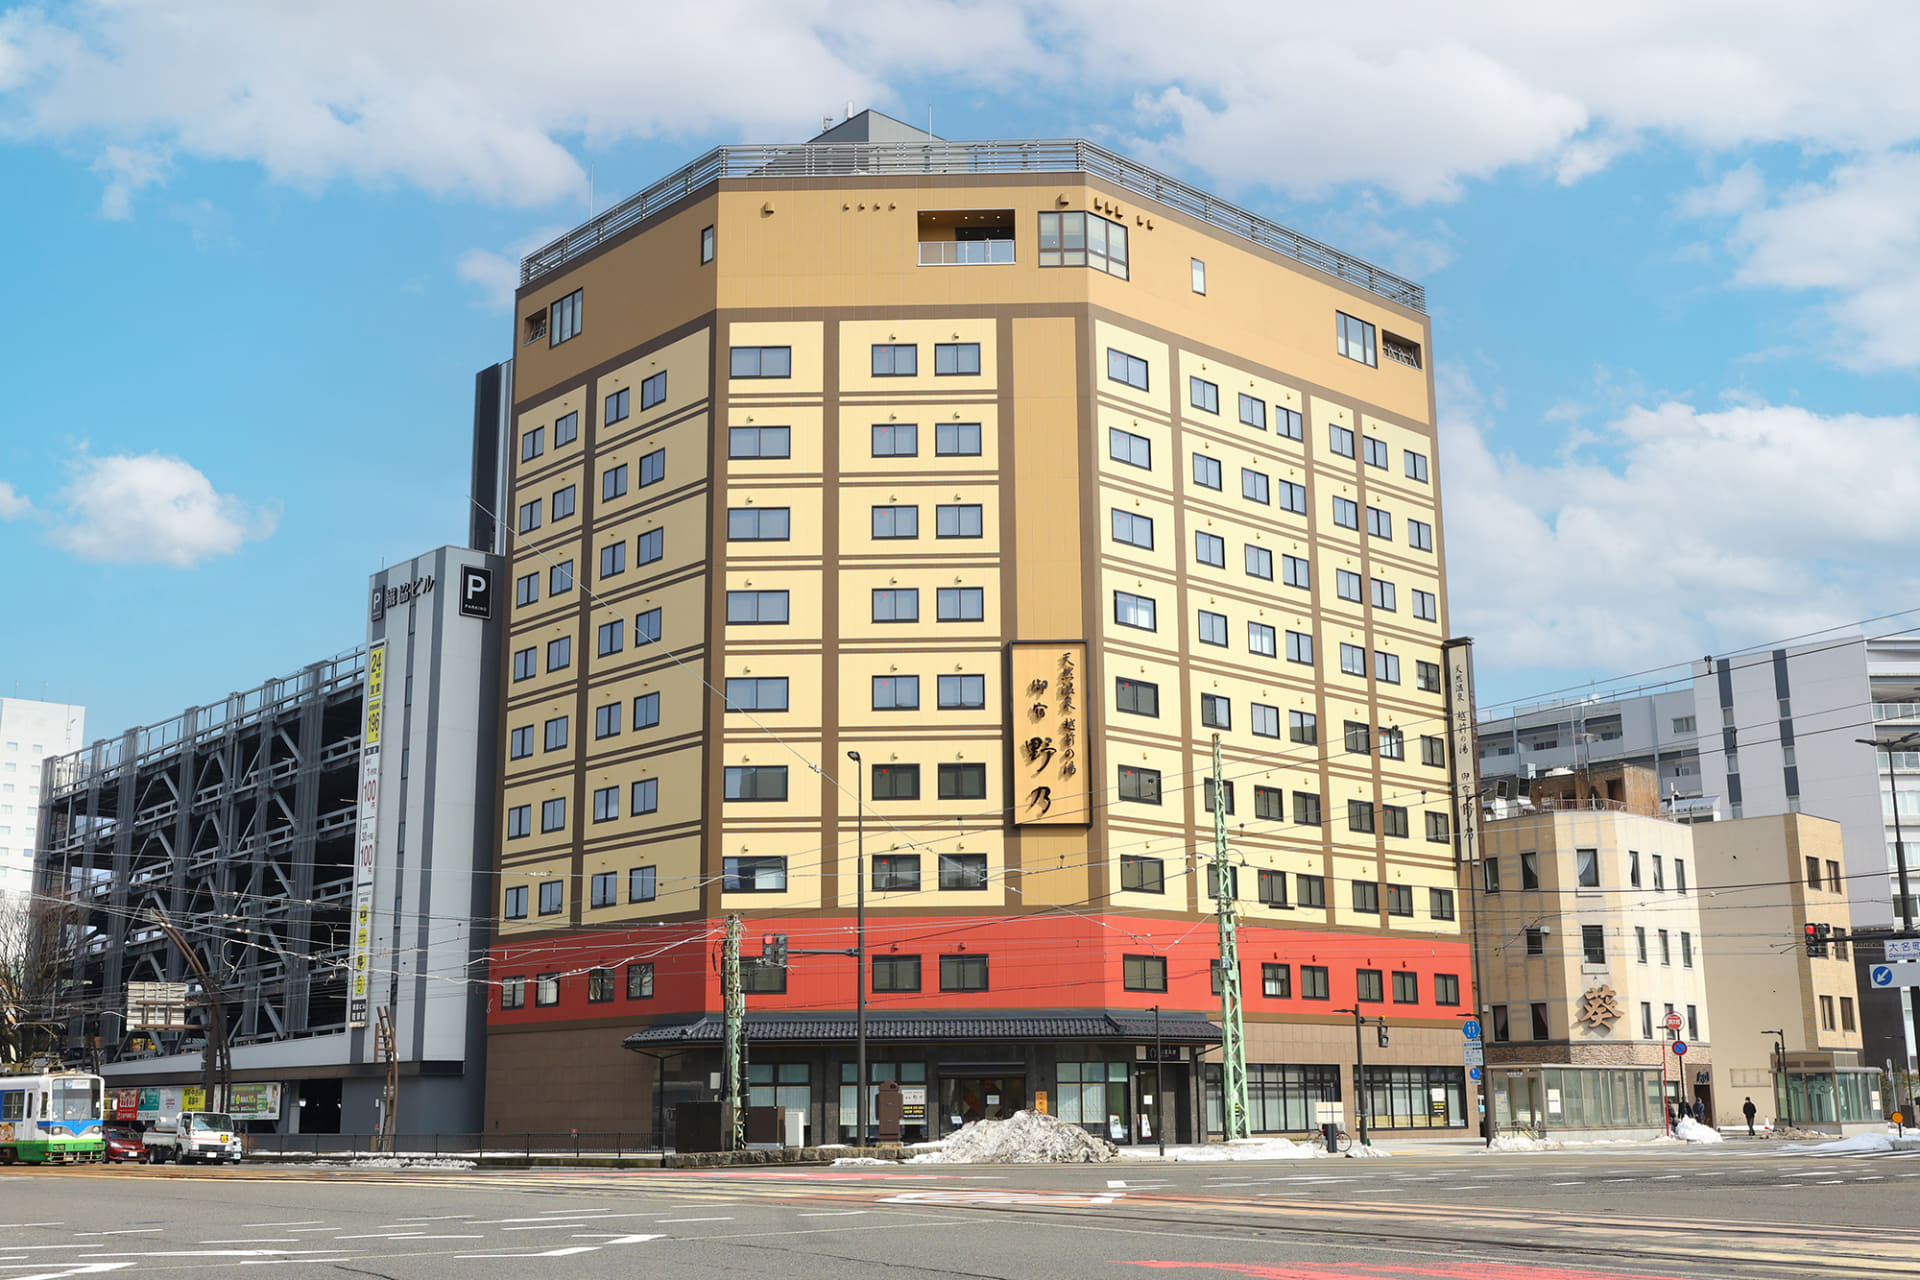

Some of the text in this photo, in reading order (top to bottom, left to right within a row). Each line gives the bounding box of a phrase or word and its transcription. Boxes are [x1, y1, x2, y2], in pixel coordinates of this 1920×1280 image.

[466, 574, 486, 600] P
[373, 592, 381, 610] P
[464, 603, 488, 612] PARKING
[1577, 984, 1624, 1032] 葵
